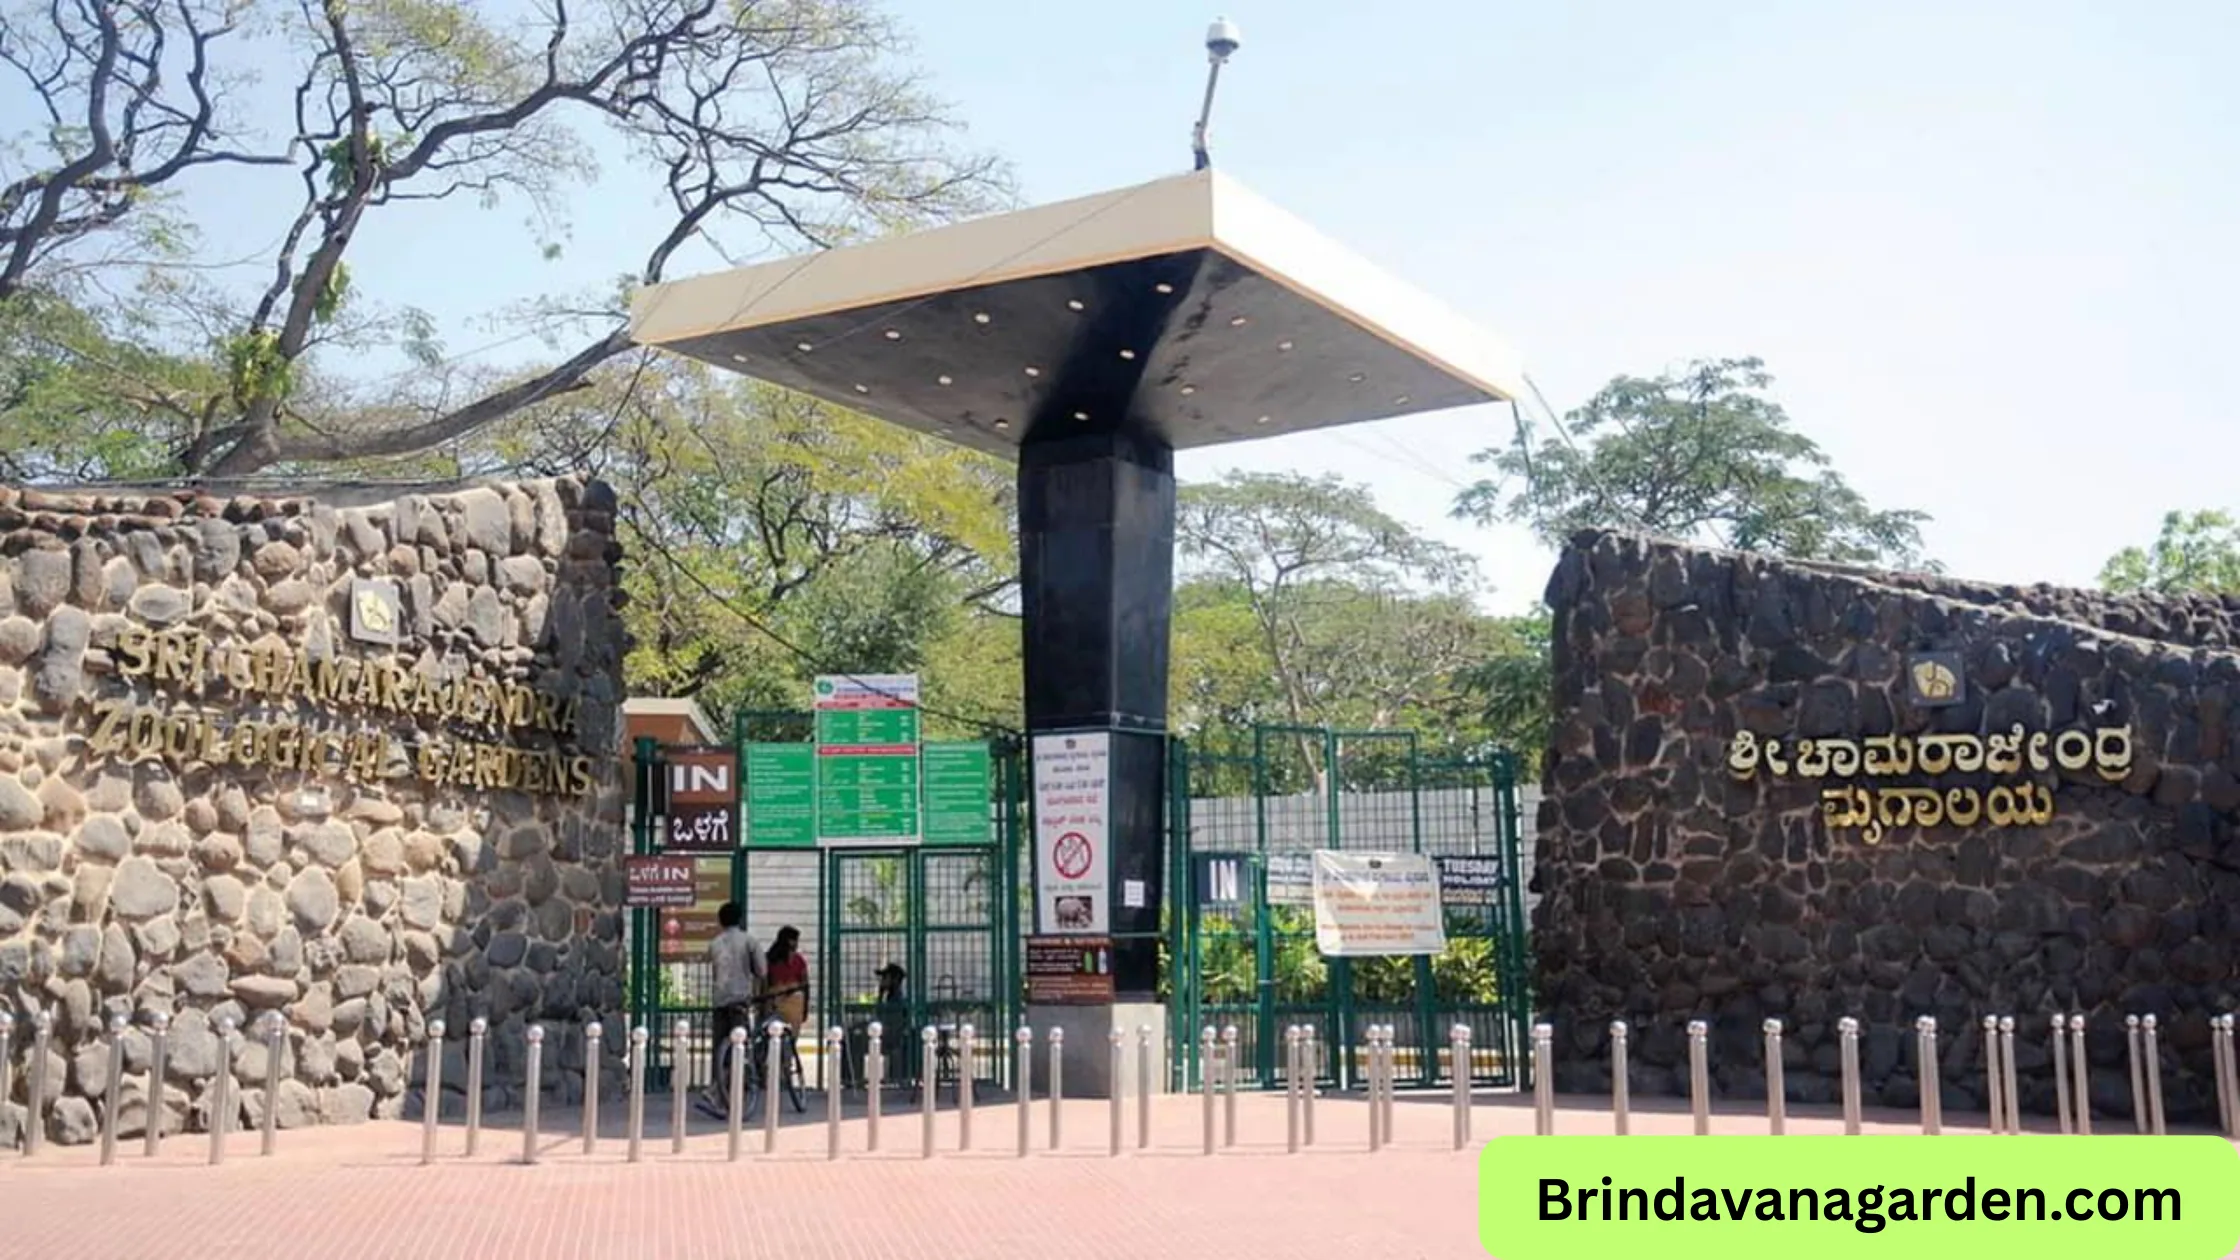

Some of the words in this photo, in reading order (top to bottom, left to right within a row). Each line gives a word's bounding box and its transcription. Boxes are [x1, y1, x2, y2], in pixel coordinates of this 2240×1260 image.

[117, 627, 206, 690] SRI
[225, 640, 581, 736] CHAMARAJENDRA
[90, 698, 406, 780] ZOOLOGICAL
[418, 738, 594, 796] GARDENS
[673, 764, 728, 792] IN
[673, 808, 729, 841] ಒಳಗೆ
[1820, 780, 2055, 845] ಮೃಗಾಲಯ
[663, 867, 690, 881] IN
[1208, 860, 1238, 901] IN
